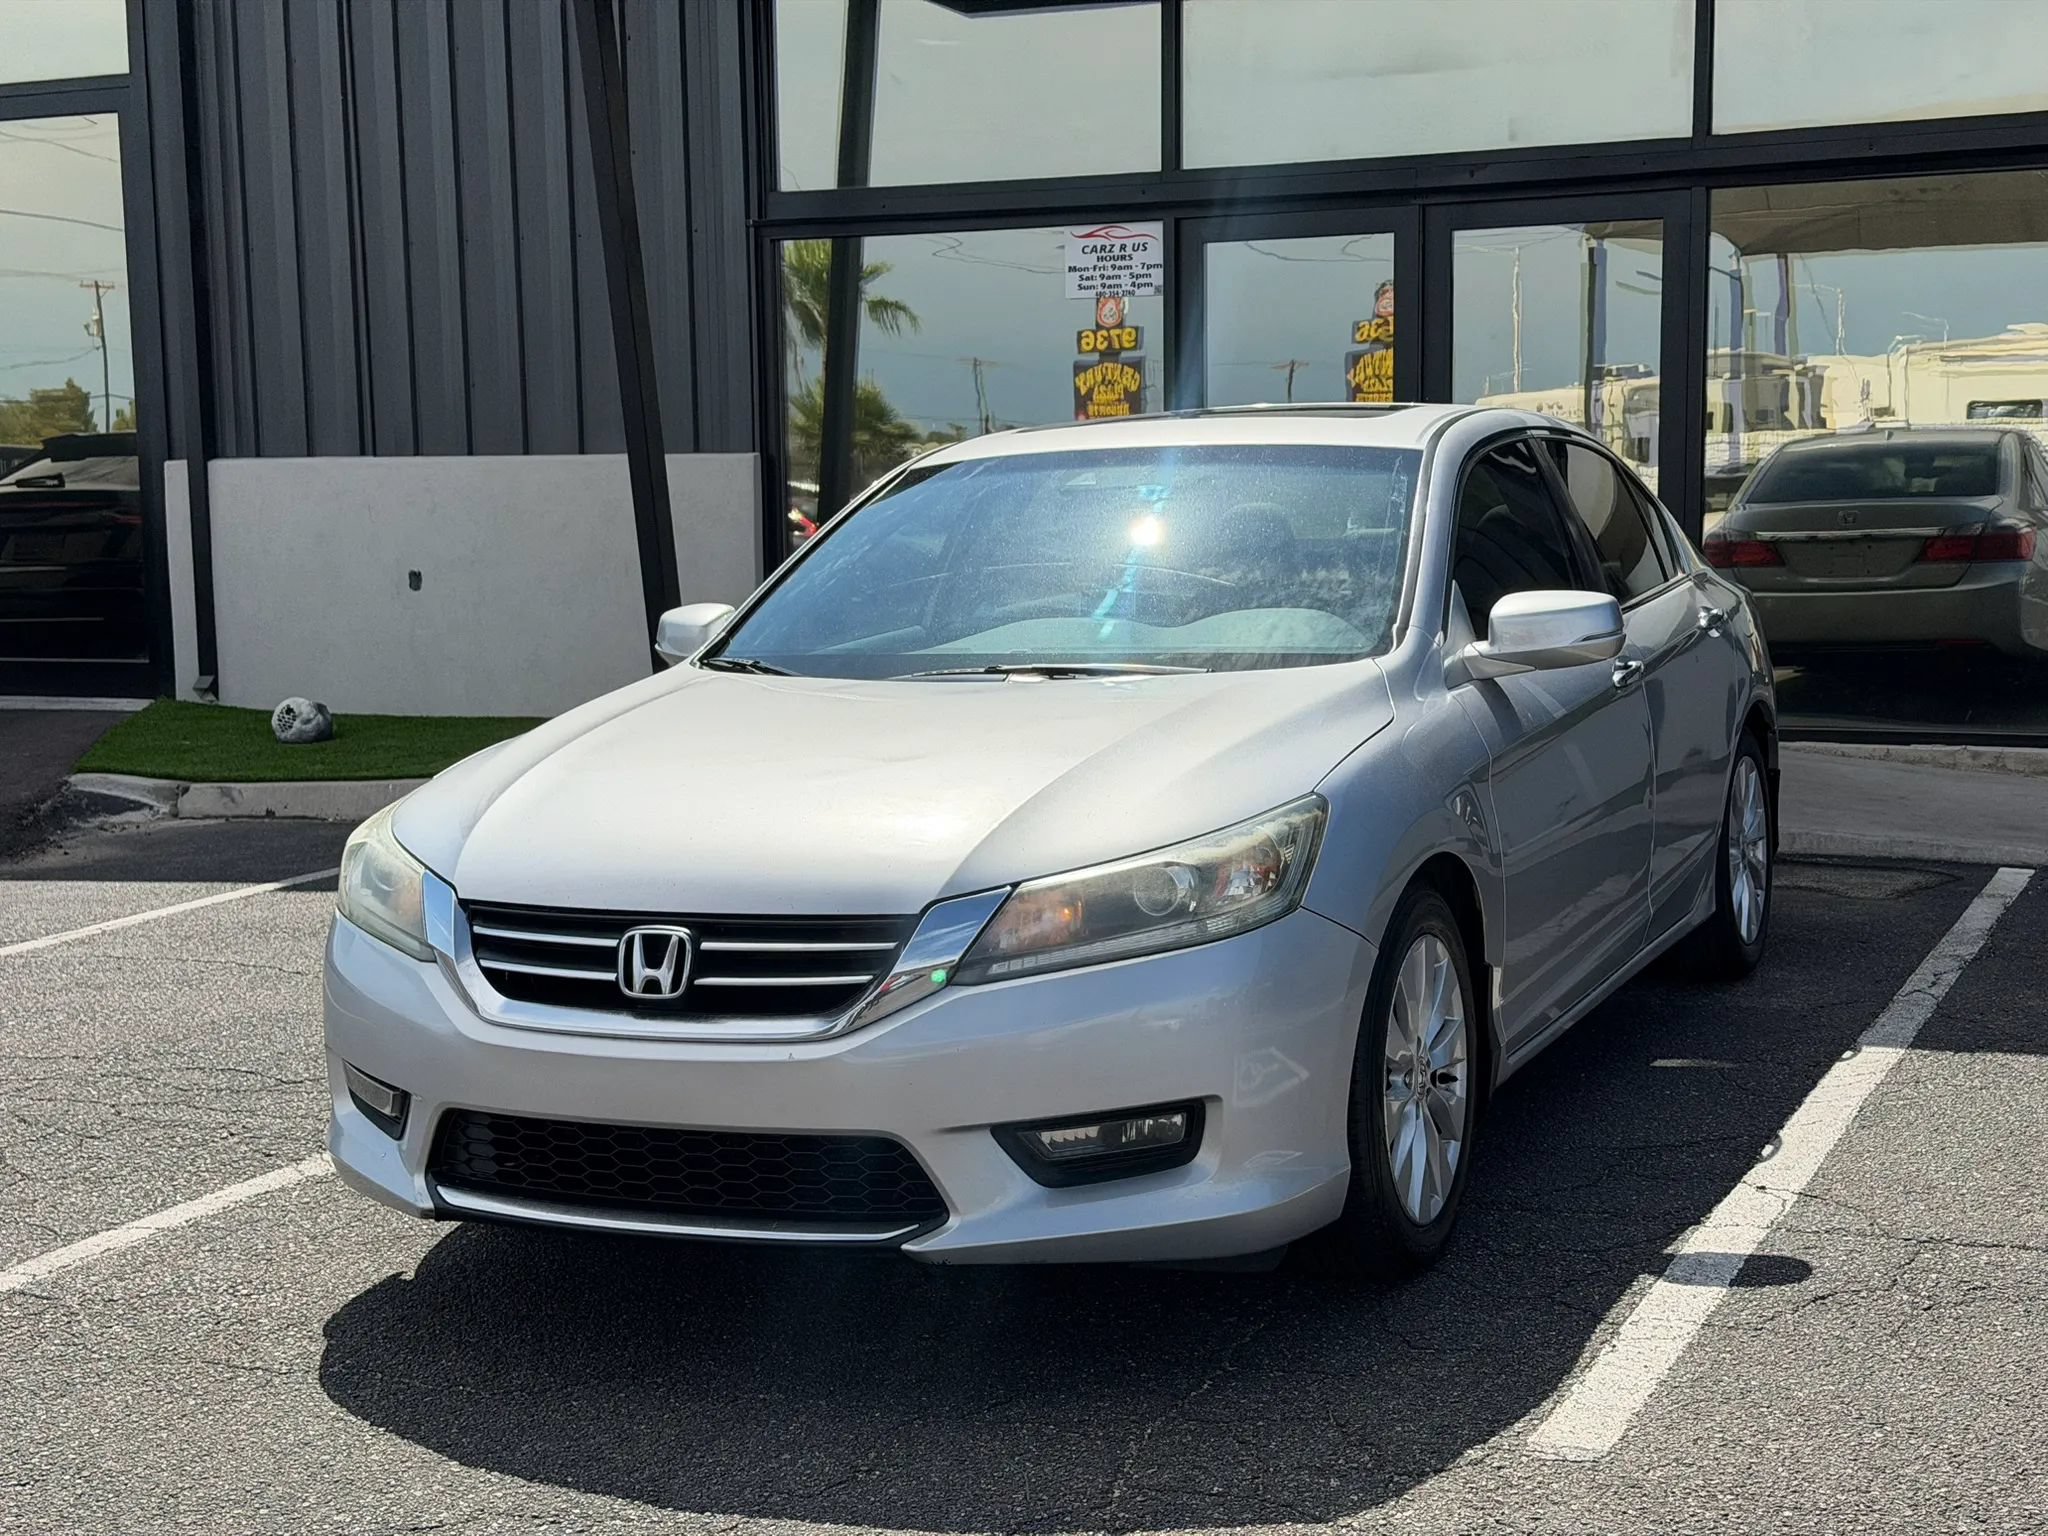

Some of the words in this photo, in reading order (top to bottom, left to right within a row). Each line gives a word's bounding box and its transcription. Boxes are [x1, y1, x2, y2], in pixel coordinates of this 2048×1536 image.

[1081, 244, 1115, 254] CARZ
[1119, 244, 1127, 253] R
[1131, 242, 1148, 252] US
[1096, 254, 1133, 263] HOURS
[1068, 265, 1109, 273] Mon-Fri:
[1110, 263, 1133, 272] 9am
[1140, 262, 1162, 270] 7pm
[1078, 274, 1098, 282] Sat:
[1098, 273, 1121, 282] 9am
[1129, 272, 1152, 281] 5pm
[1100, 282, 1122, 291] 9am
[1130, 281, 1153, 290] 4pm
